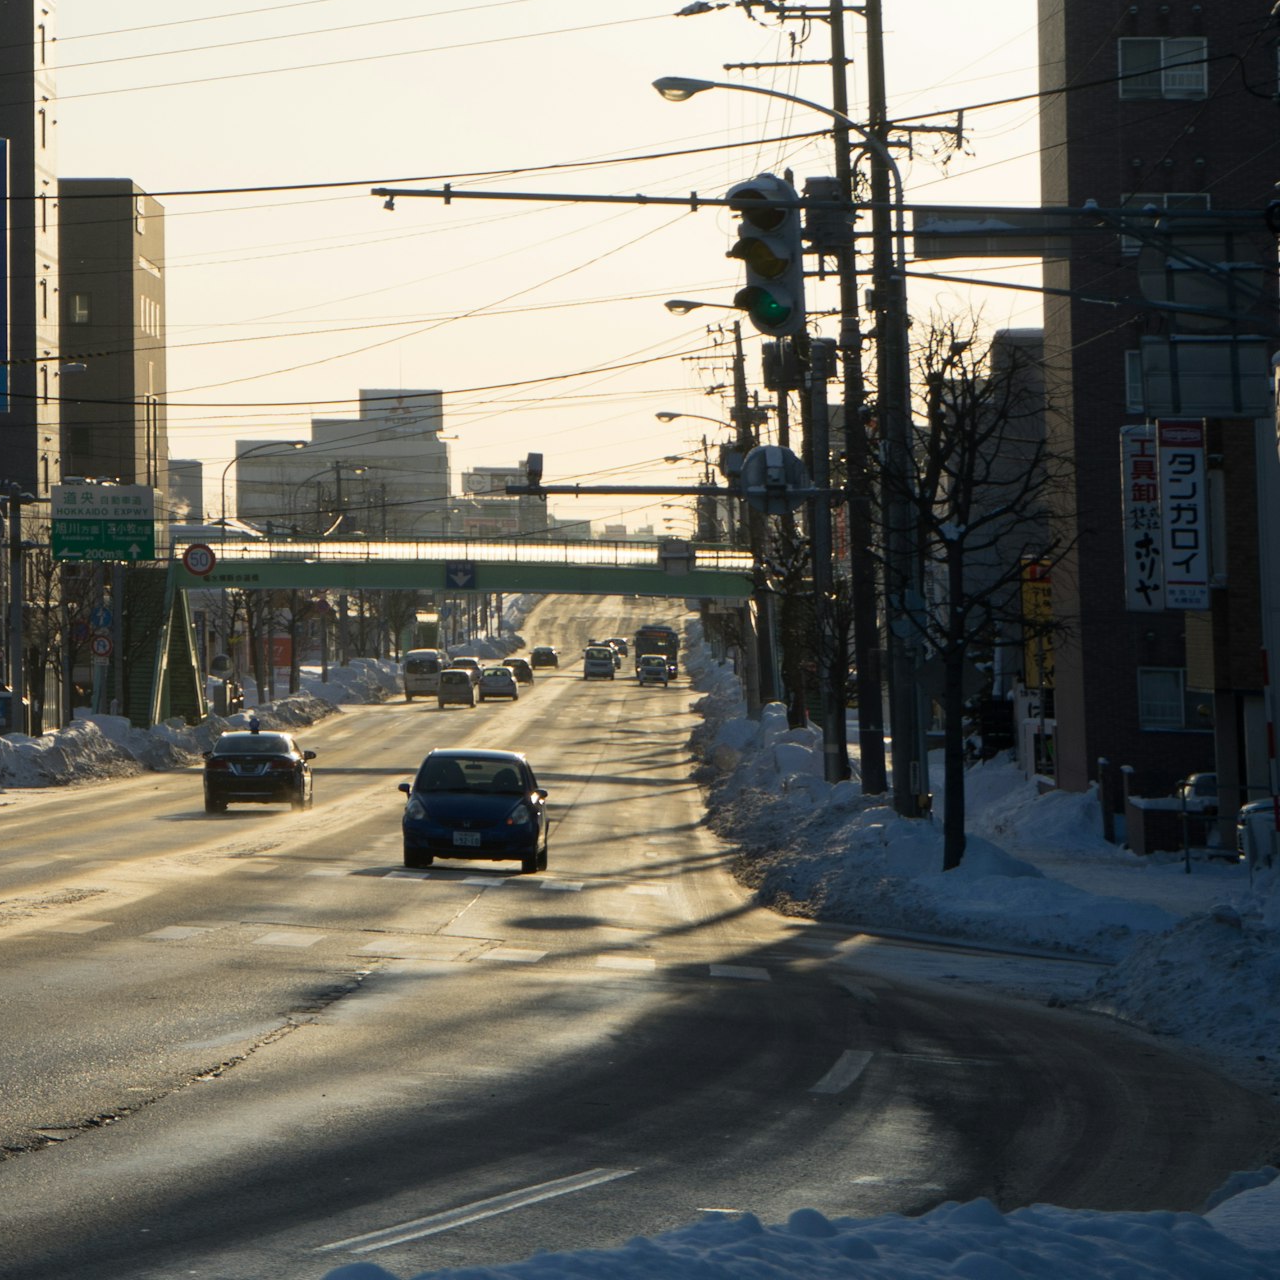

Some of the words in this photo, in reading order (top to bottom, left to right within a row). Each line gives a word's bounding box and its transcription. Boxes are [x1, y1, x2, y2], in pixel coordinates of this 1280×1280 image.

[1130, 438, 1157, 503] 工具卸
[56, 508, 108, 516] HOKKAIDO
[114, 508, 148, 516] EXPWY
[1168, 454, 1200, 573] タンガロイ
[190, 553, 208, 567] 50
